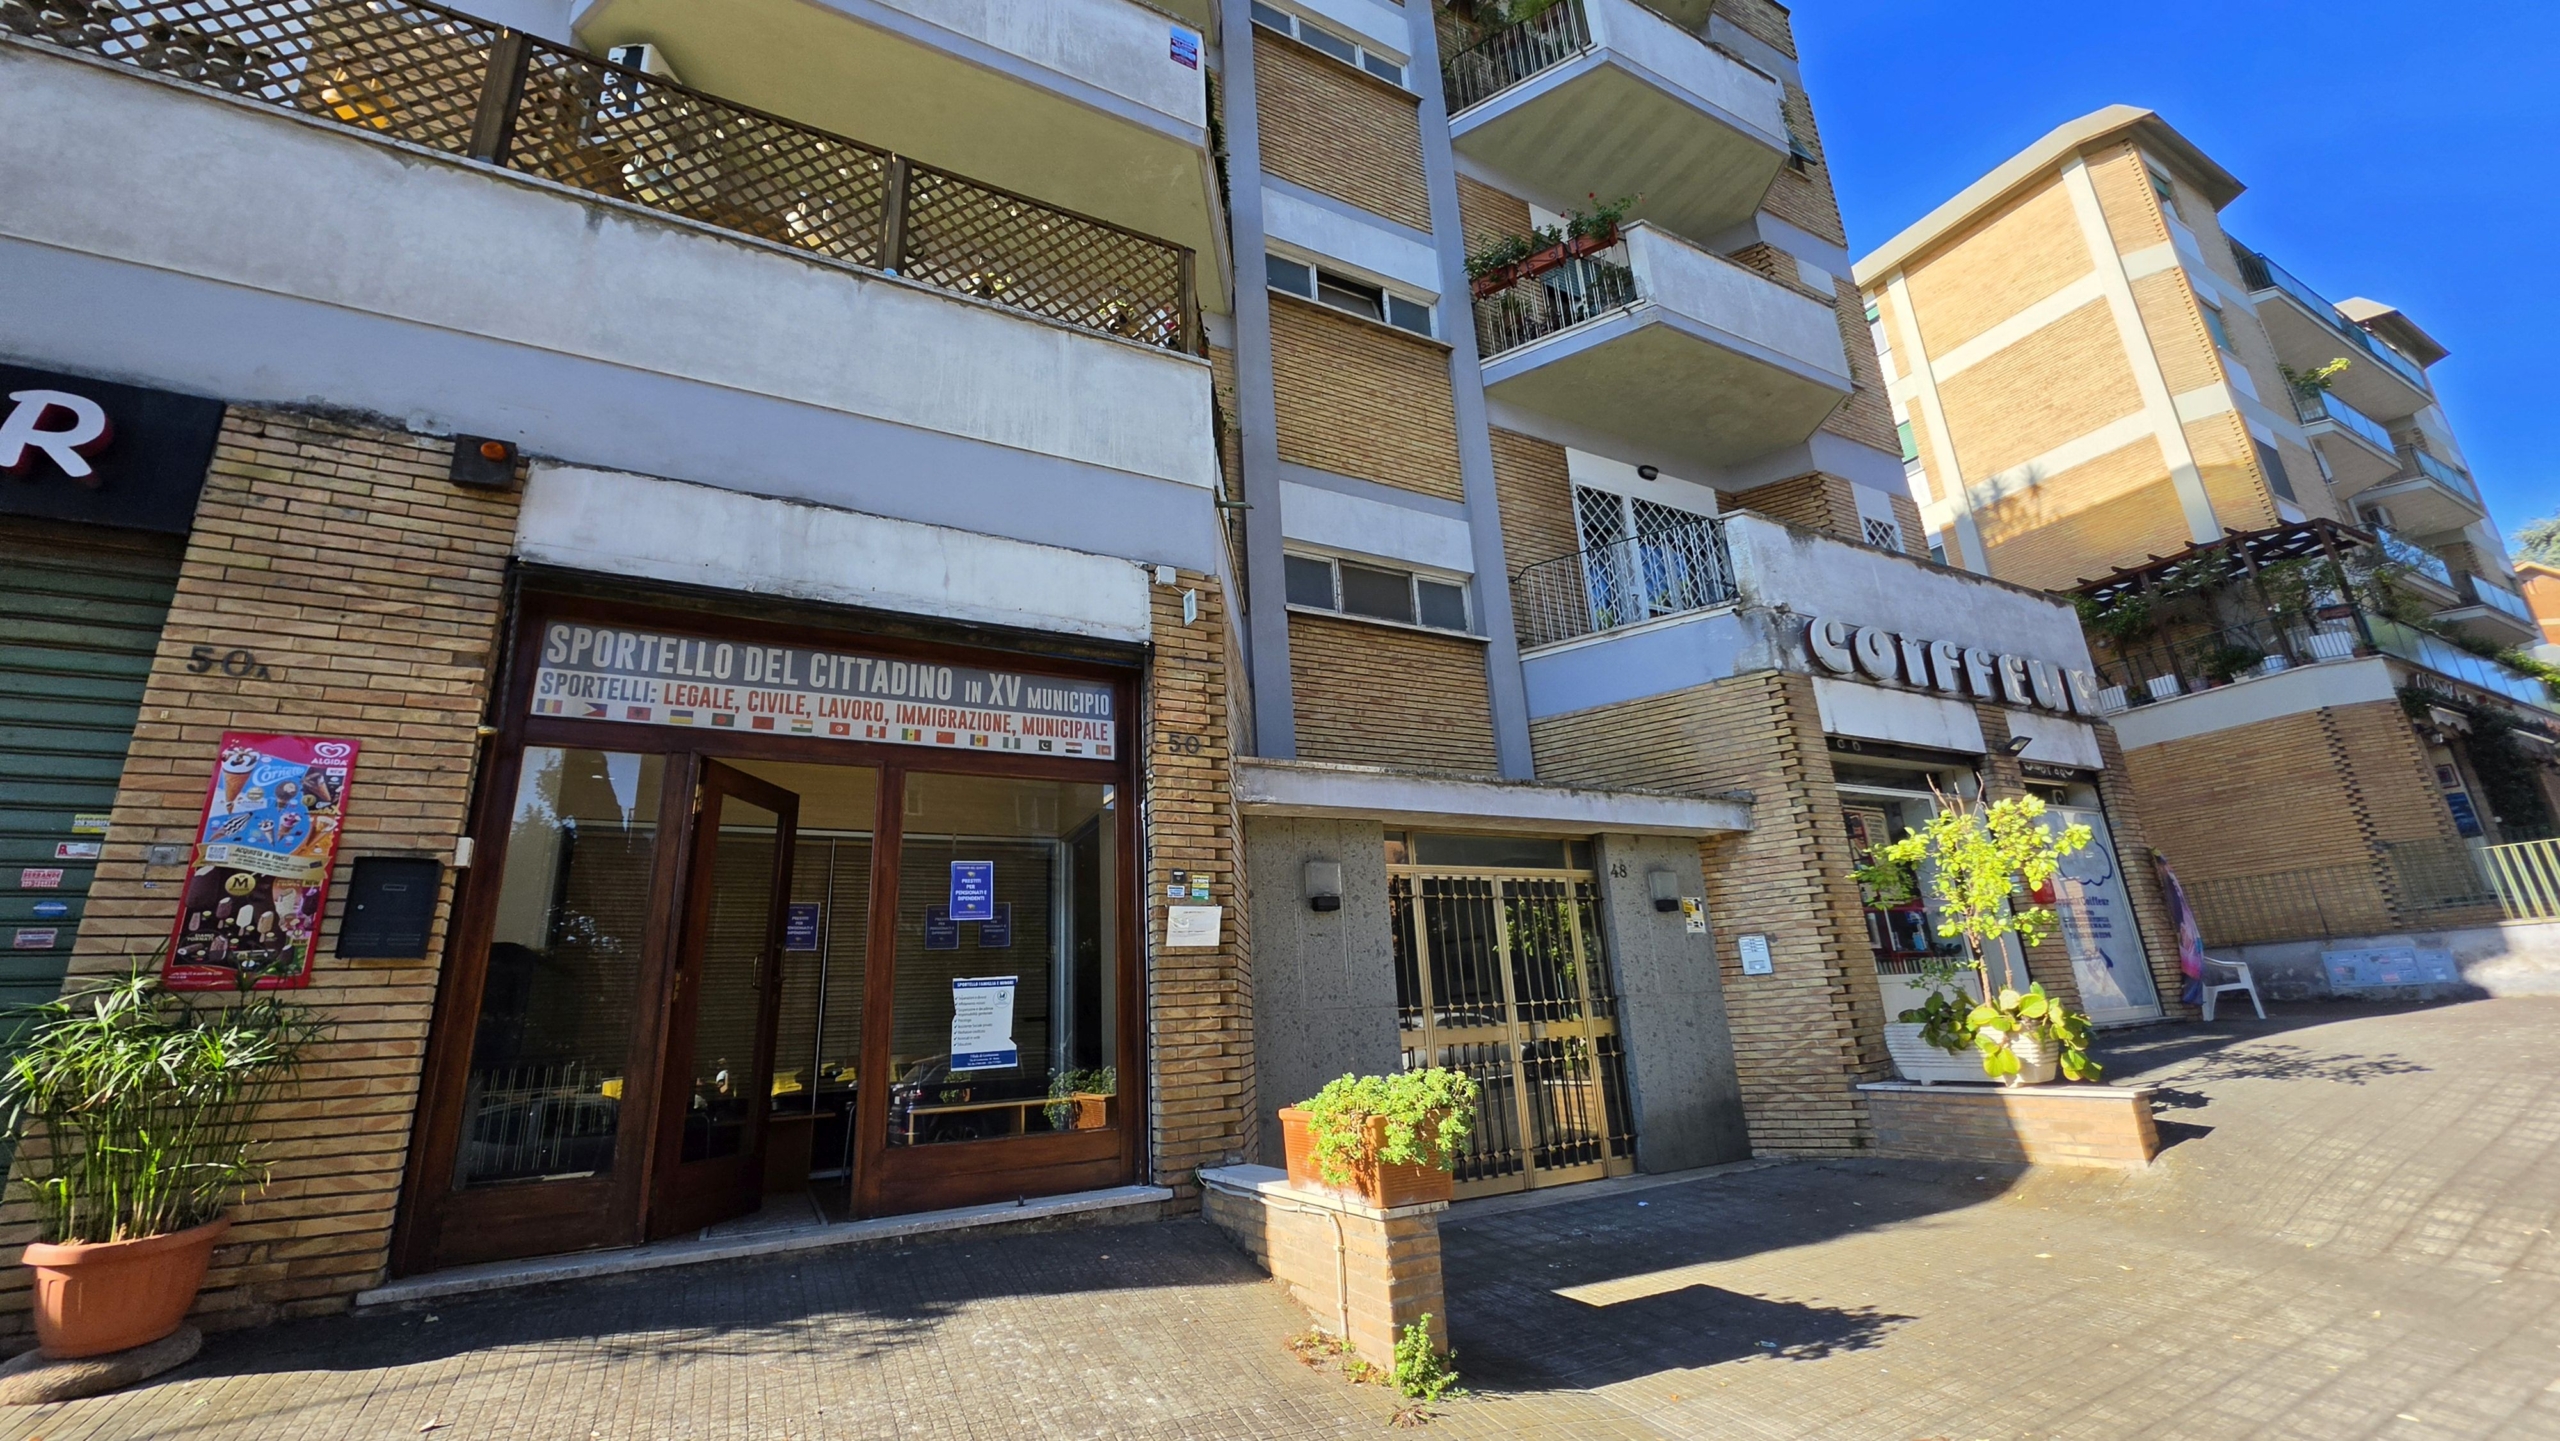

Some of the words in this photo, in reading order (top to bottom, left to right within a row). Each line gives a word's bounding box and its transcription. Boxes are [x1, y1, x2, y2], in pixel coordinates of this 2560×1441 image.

[546, 624, 734, 680] SPORTELLO
[743, 645, 799, 686] DEL
[808, 652, 953, 701] CITTADINO
[965, 680, 982, 704] IN
[988, 672, 1021, 708] XV
[1027, 687, 1110, 716] MUNICIPIO
[540, 671, 657, 704] SPORTELLI:
[663, 682, 741, 714] LEGALE,
[747, 690, 812, 719] CIVILE,
[818, 696, 889, 726] LAVORO,
[896, 703, 1017, 737] IMMIGRAZIONE,
[1022, 718, 1108, 742] MUNICIPALE
[1168, 734, 1200, 755] 50
[311, 757, 347, 766] ALGIDA
[252, 764, 304, 787] Cornetto
[1610, 863, 1628, 878] 48
